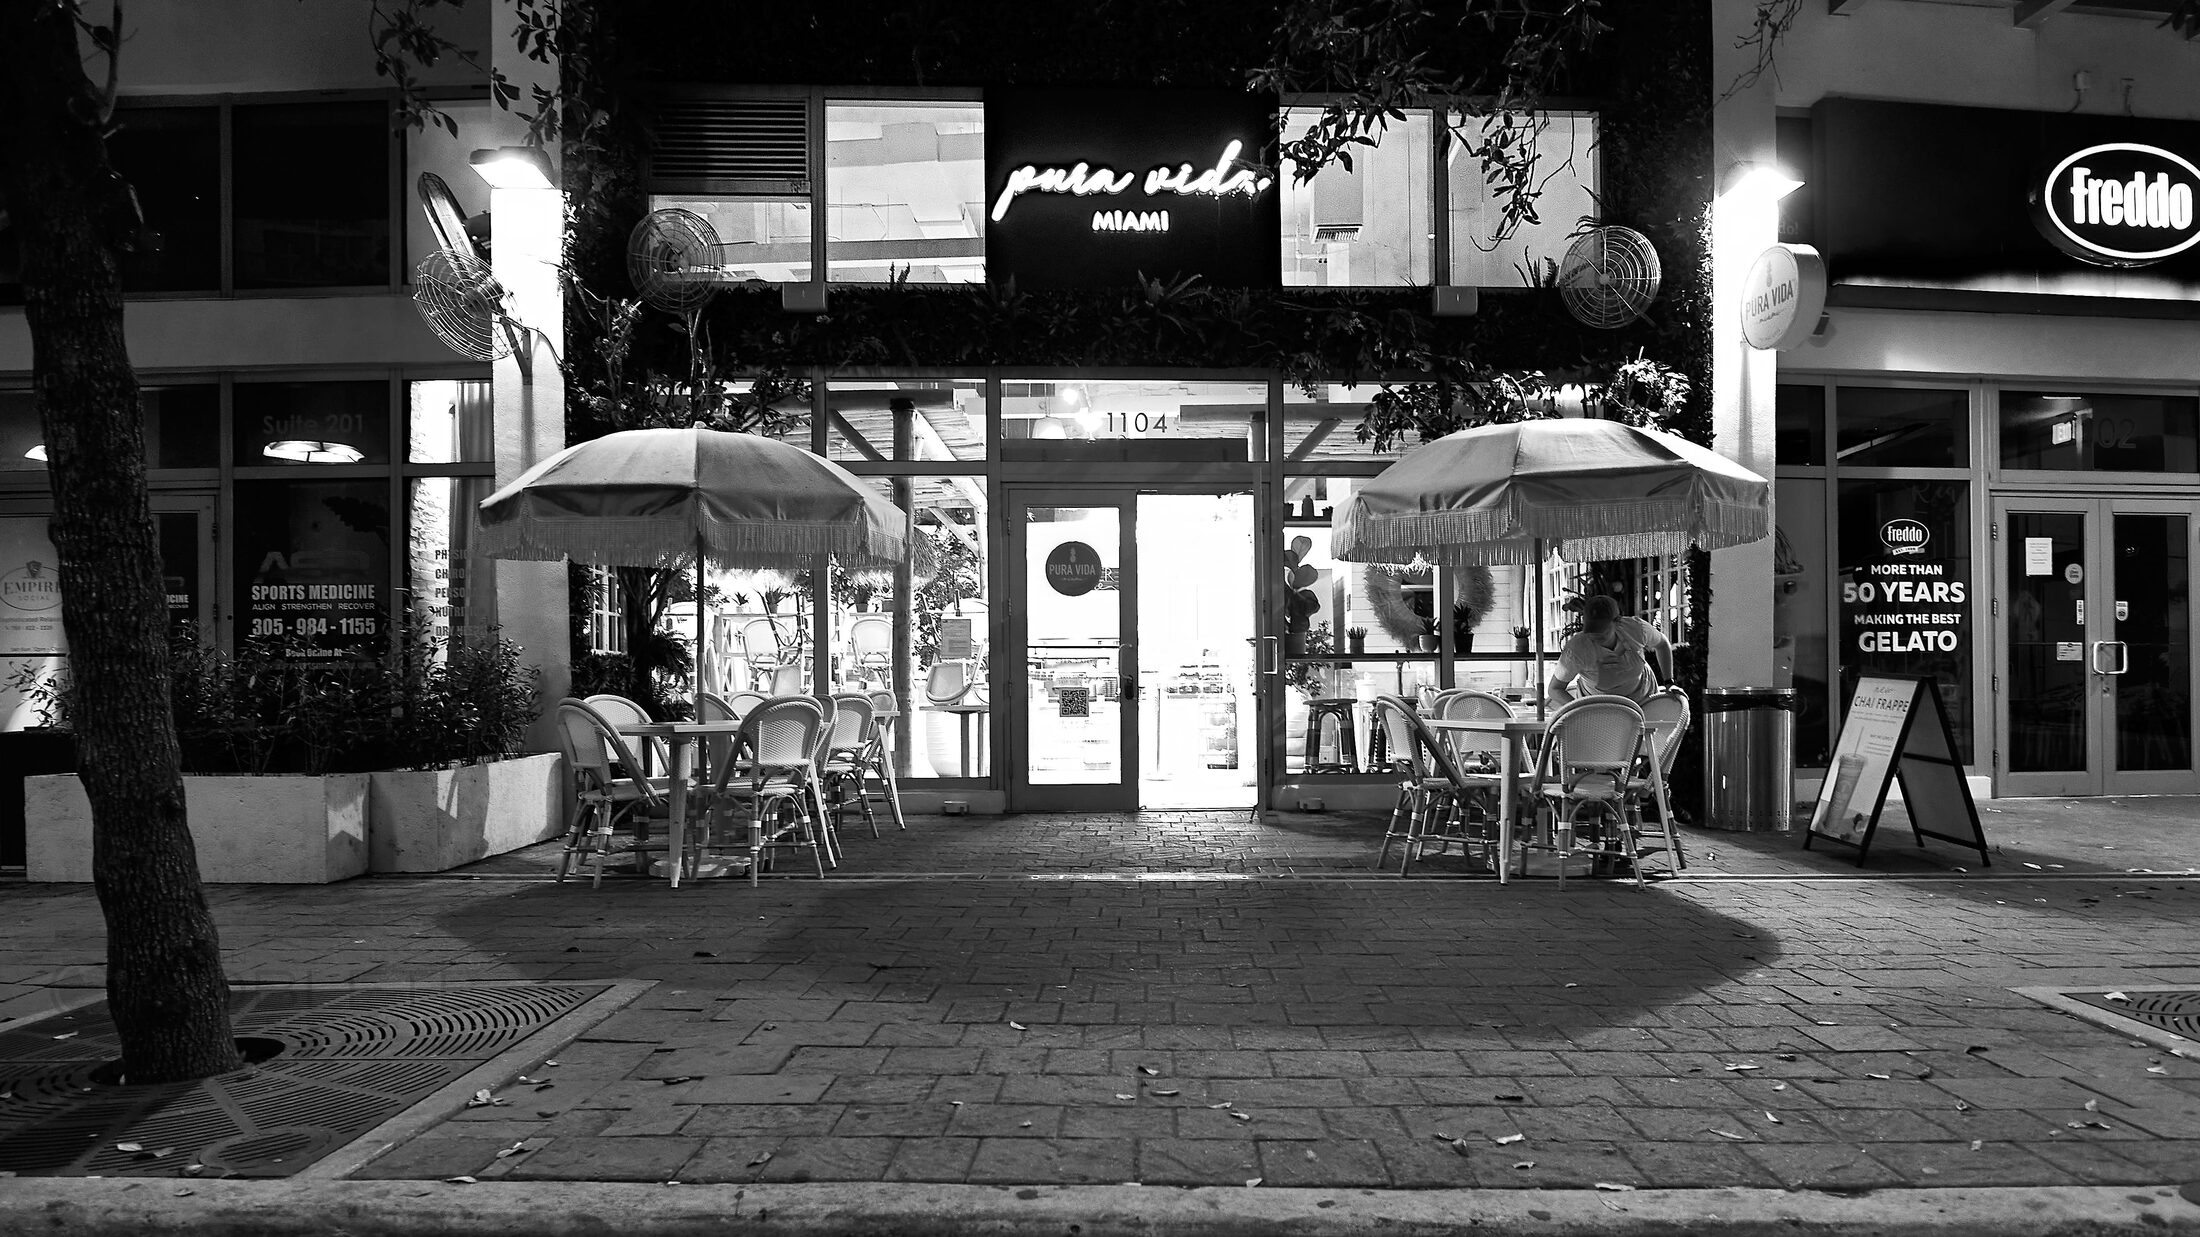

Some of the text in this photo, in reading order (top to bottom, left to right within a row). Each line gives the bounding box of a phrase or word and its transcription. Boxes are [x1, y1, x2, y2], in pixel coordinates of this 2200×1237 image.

[991, 162, 1135, 222] pura
[2069, 166, 2194, 231] freddo
[1092, 209, 1169, 232] MIAMI
[1745, 280, 1794, 320] PURA VIDA
[263, 414, 363, 435] Suite 201
[1106, 412, 1168, 434] 1104
[1887, 525, 1923, 542] freddo
[1048, 563, 1097, 576] PURA VIDA
[1870, 564, 1944, 576] MORE THAN
[251, 584, 375, 600] SPORTS MEDICINE
[1843, 581, 1966, 604] 50 YEARS
[252, 603, 276, 611] ALIGN
[281, 603, 332, 611] STRENGTHEN
[1854, 614, 1962, 626] MAKING THE BEST
[1858, 630, 1958, 652] GELATO
[1854, 695, 1910, 713] CHAI FRAPPE
